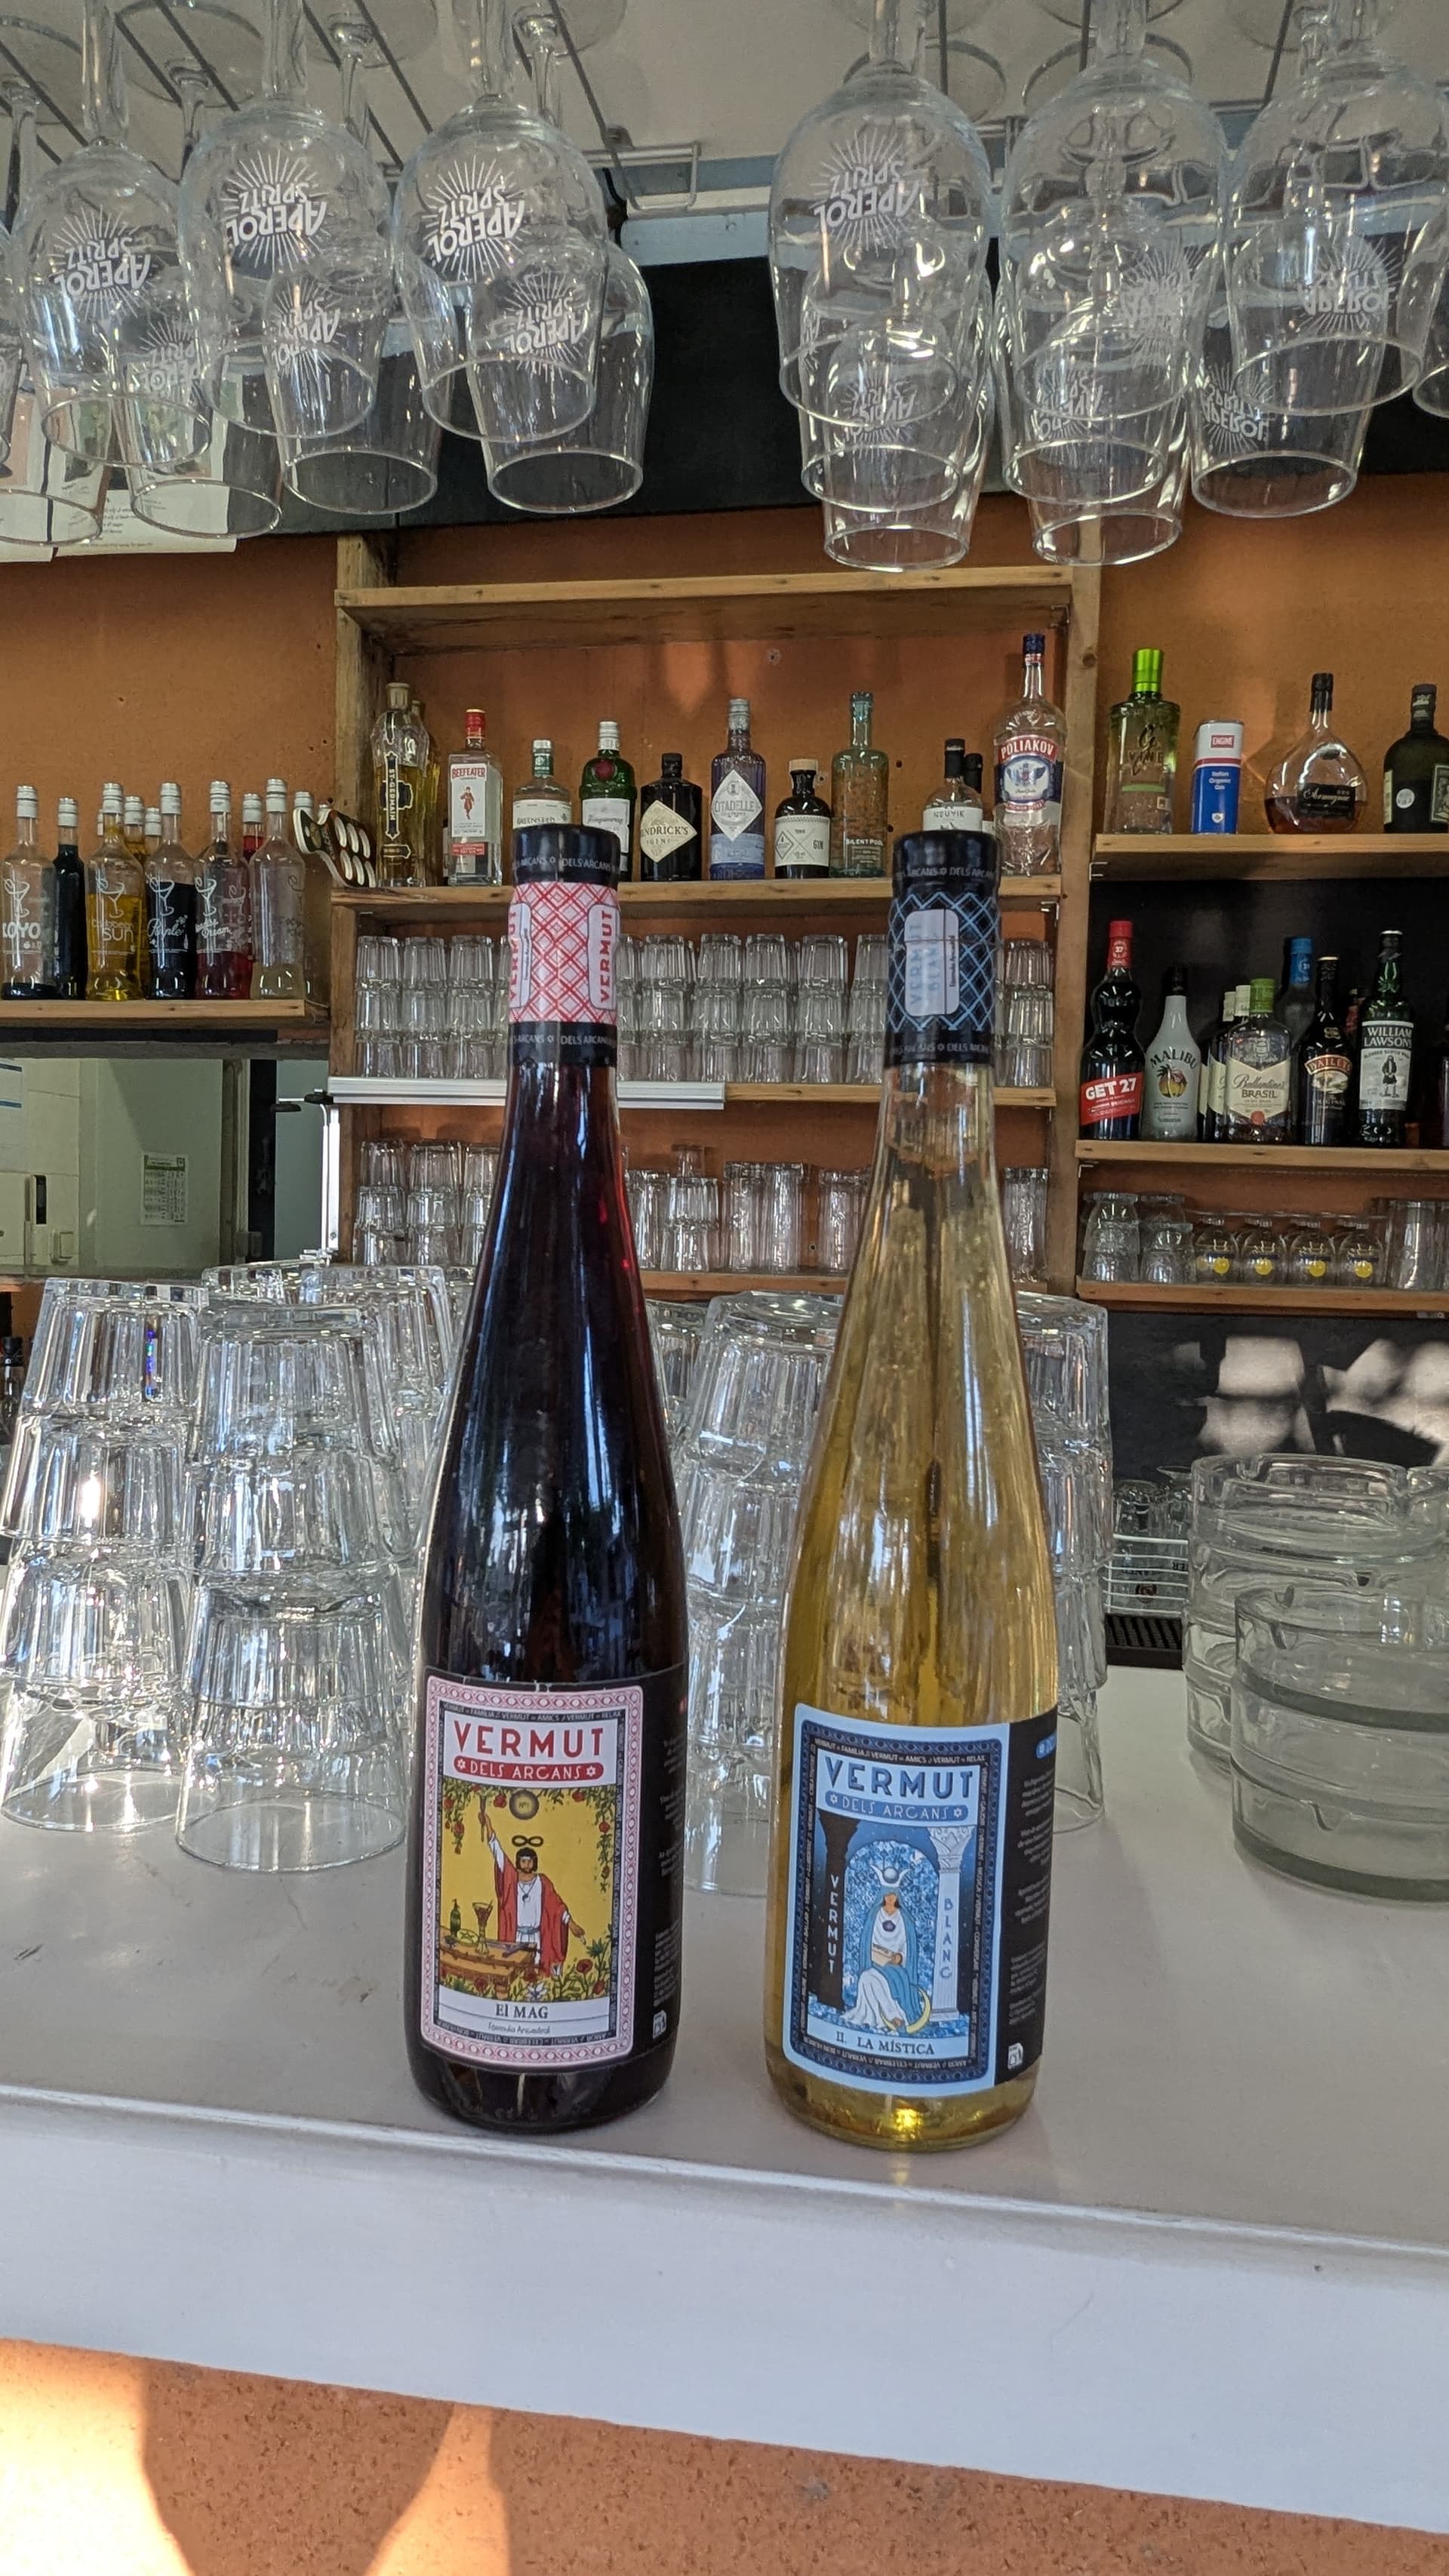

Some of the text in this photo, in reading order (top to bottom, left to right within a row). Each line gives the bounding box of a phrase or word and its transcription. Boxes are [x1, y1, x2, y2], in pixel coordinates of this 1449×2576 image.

[831, 161, 904, 199] SPRITZ
[239, 183, 309, 214] SPRITZ
[439, 186, 506, 232] SPRITZ
[814, 180, 919, 234] APEROL
[226, 201, 326, 246] APEROL
[428, 199, 525, 263] APEROL
[66, 237, 132, 269] SPRITZ
[55, 254, 150, 297] APEROL
[505, 309, 589, 353] APEROL
[1001, 739, 1054, 759] POLIAKOV
[1213, 737, 1232, 746] ENGINE
[453, 766, 485, 778] BEEFEATER
[715, 801, 755, 812] CITADELLE
[641, 824, 688, 837] ENDRICK'S
[813, 839, 823, 850] GIN
[562, 857, 583, 867] DELS
[600, 910, 612, 1002] VERMUT
[561, 1035, 582, 1045] DELS
[1367, 1026, 1412, 1039] WILLIAM
[1150, 1049, 1198, 1069] MALIBU
[1310, 1054, 1352, 1071] BAILEYS
[1085, 1077, 1137, 1100] GET 27
[1241, 1089, 1278, 1098] BRASIL
[443, 1702, 465, 1713] VERMUT
[470, 1708, 495, 1719] FAMILIA
[501, 1712, 530, 1721] VERMUT
[601, 1710, 621, 1719] RELAX
[454, 1720, 604, 1758] VERMUT
[815, 1738, 836, 1750] VERMUT
[841, 1745, 864, 1756] FAMILIA
[871, 1751, 898, 1762] VERMUT
[906, 1755, 927, 1764] AMICS
[934, 1756, 961, 1764] VERMUT
[470, 1760, 581, 1780] DELS ARCANS
[825, 1756, 973, 1799] VERMUT
[841, 1797, 948, 1820] DELS ARCANS
[827, 1874, 839, 1974] VERMUT
[940, 1898, 953, 1978] BLANC
[514, 2006, 549, 2019] MAG
[857, 2036, 874, 2050] LA
[878, 2039, 934, 2055] MÍSTICA
